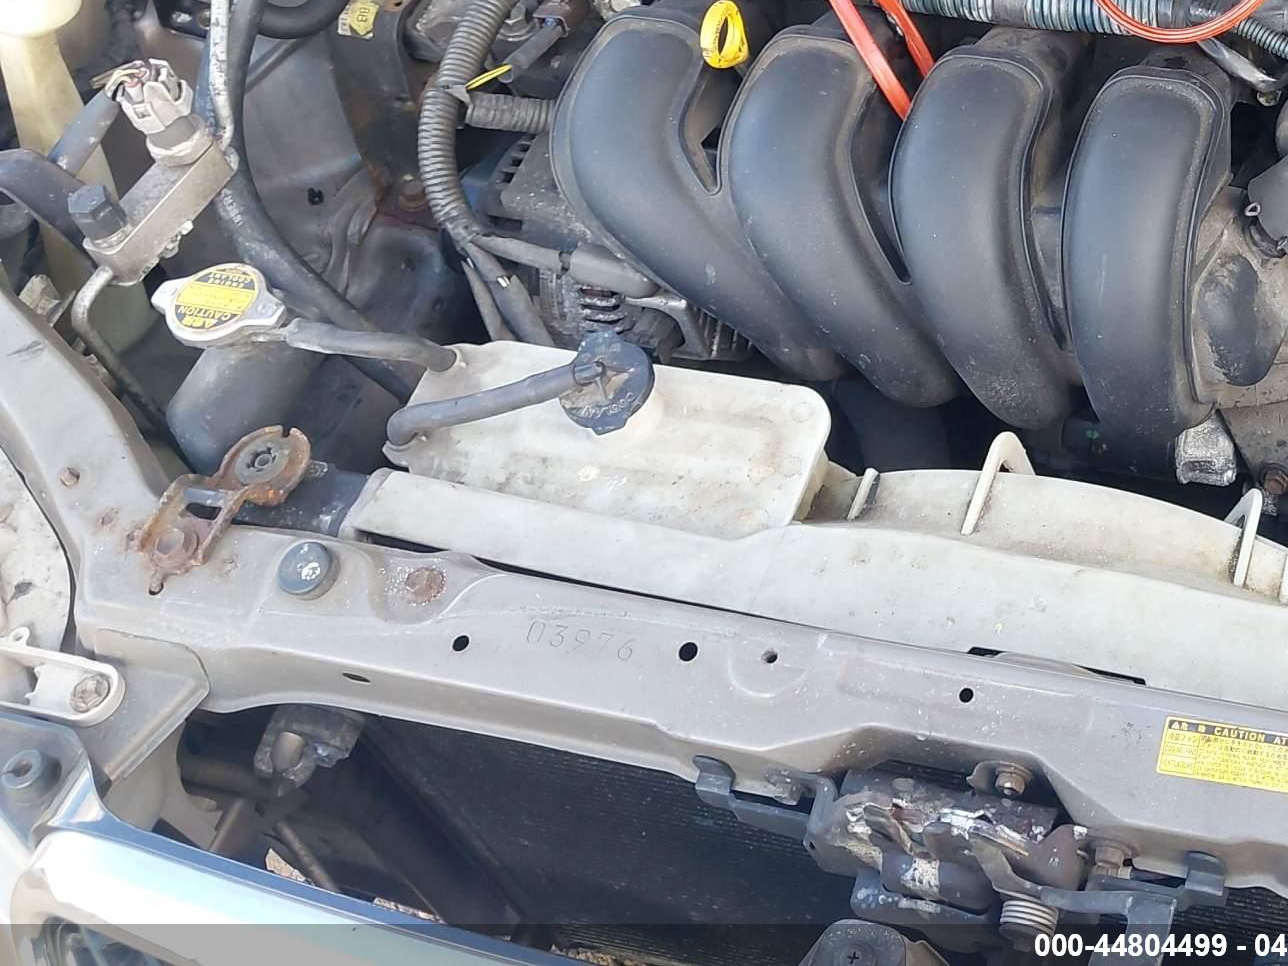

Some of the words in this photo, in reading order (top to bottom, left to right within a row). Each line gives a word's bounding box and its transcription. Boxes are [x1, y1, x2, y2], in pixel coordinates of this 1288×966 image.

[177, 305, 231, 322] CAUTION
[526, 619, 637, 661] 03976
[1213, 725, 1266, 744] CAUTION
